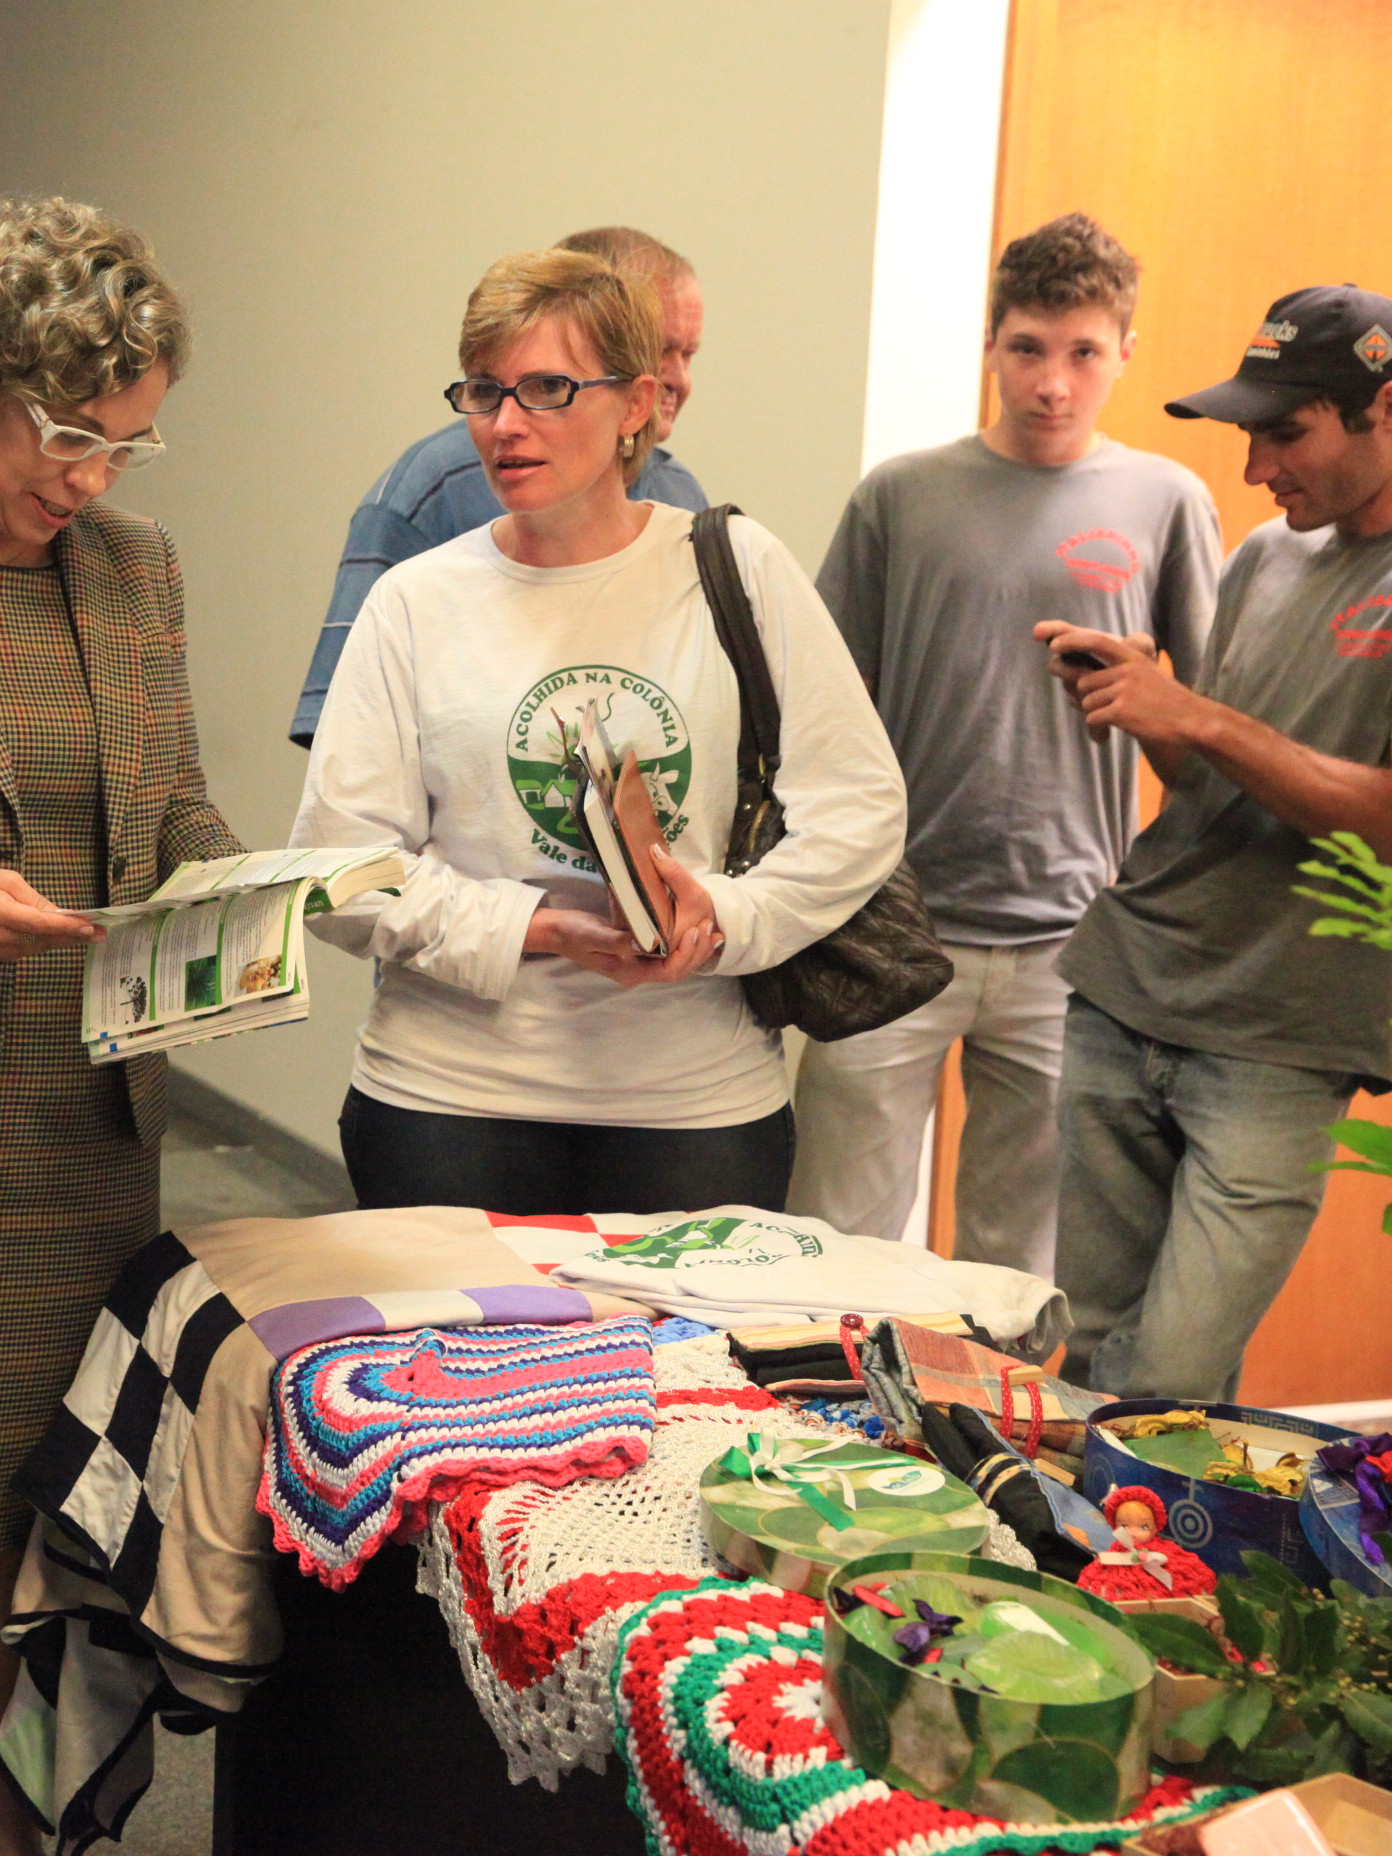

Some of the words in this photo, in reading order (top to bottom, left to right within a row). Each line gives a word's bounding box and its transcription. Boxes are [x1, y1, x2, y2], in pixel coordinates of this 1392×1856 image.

[514, 672, 578, 753] ACOLHIDA
[584, 672, 612, 685] NA
[619, 676, 679, 749] COLÔNIA
[530, 828, 569, 865] Vale
[571, 855, 599, 874] da
